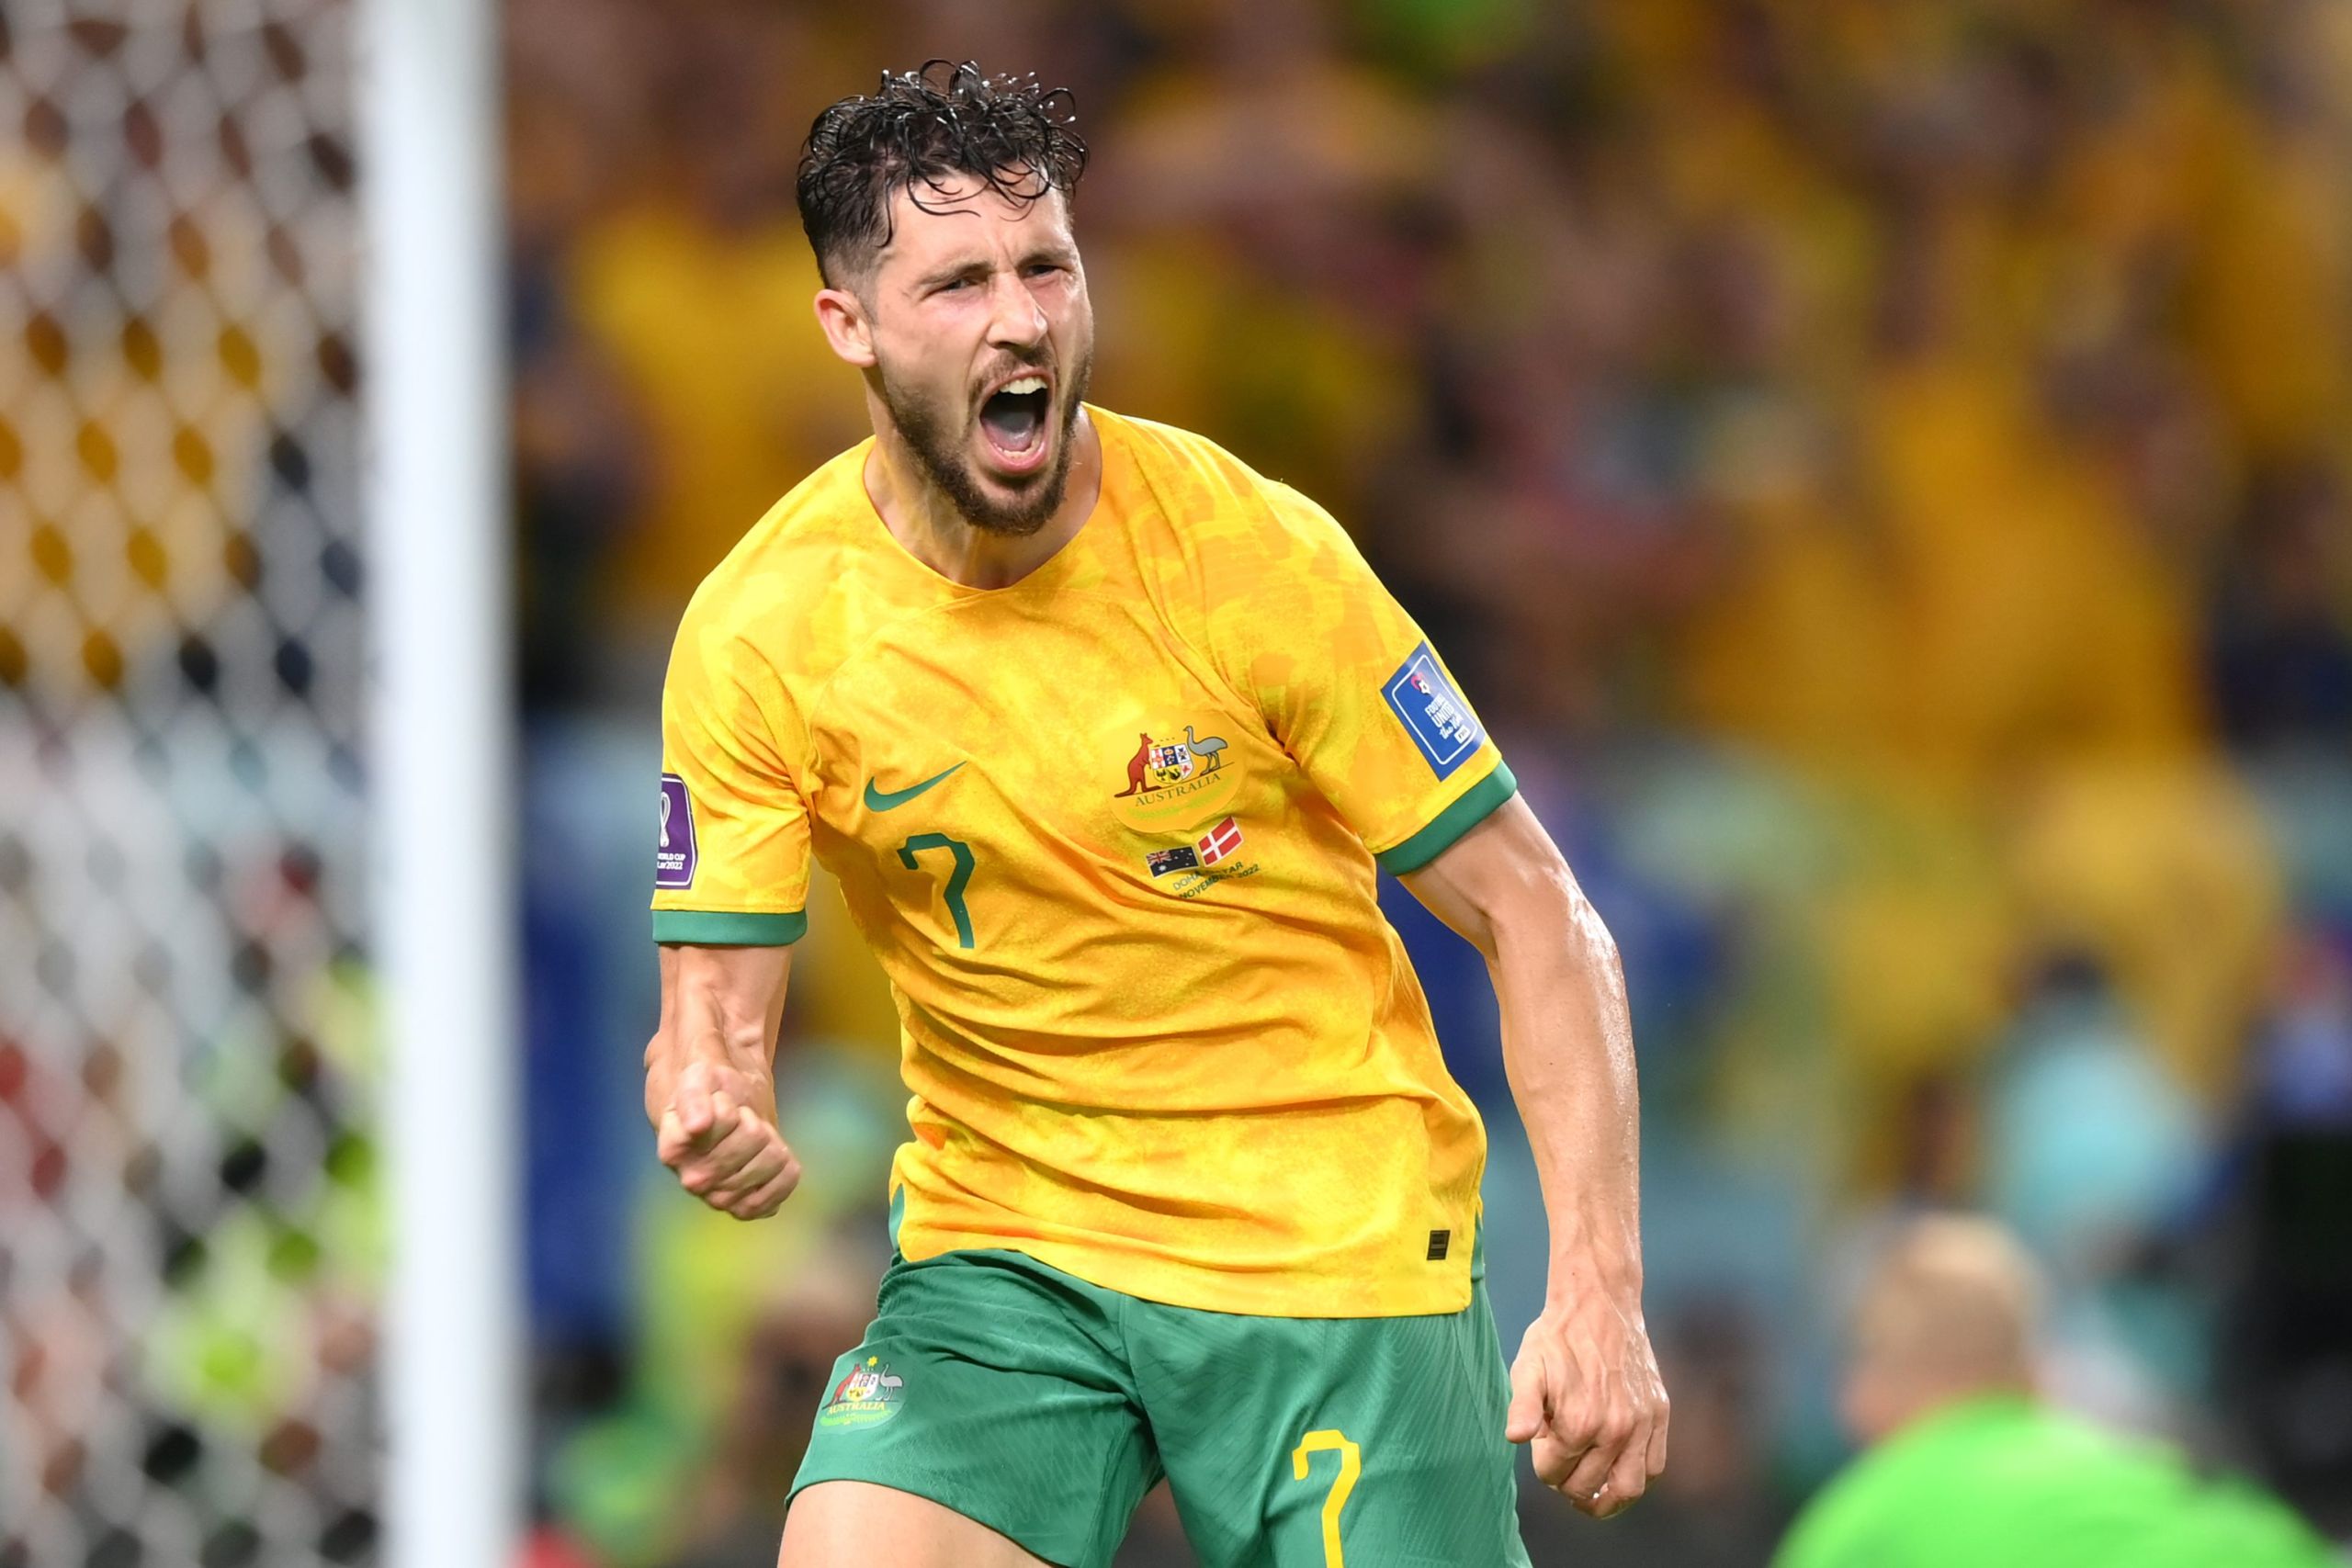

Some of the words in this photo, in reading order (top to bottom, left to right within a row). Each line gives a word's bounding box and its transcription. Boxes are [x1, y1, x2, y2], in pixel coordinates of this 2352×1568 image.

[1136, 773, 1220, 807] AUSTRALIA
[897, 832, 975, 949] 7
[828, 1401, 885, 1415] AUSTRALIA
[1292, 1429, 1362, 1568] 7
